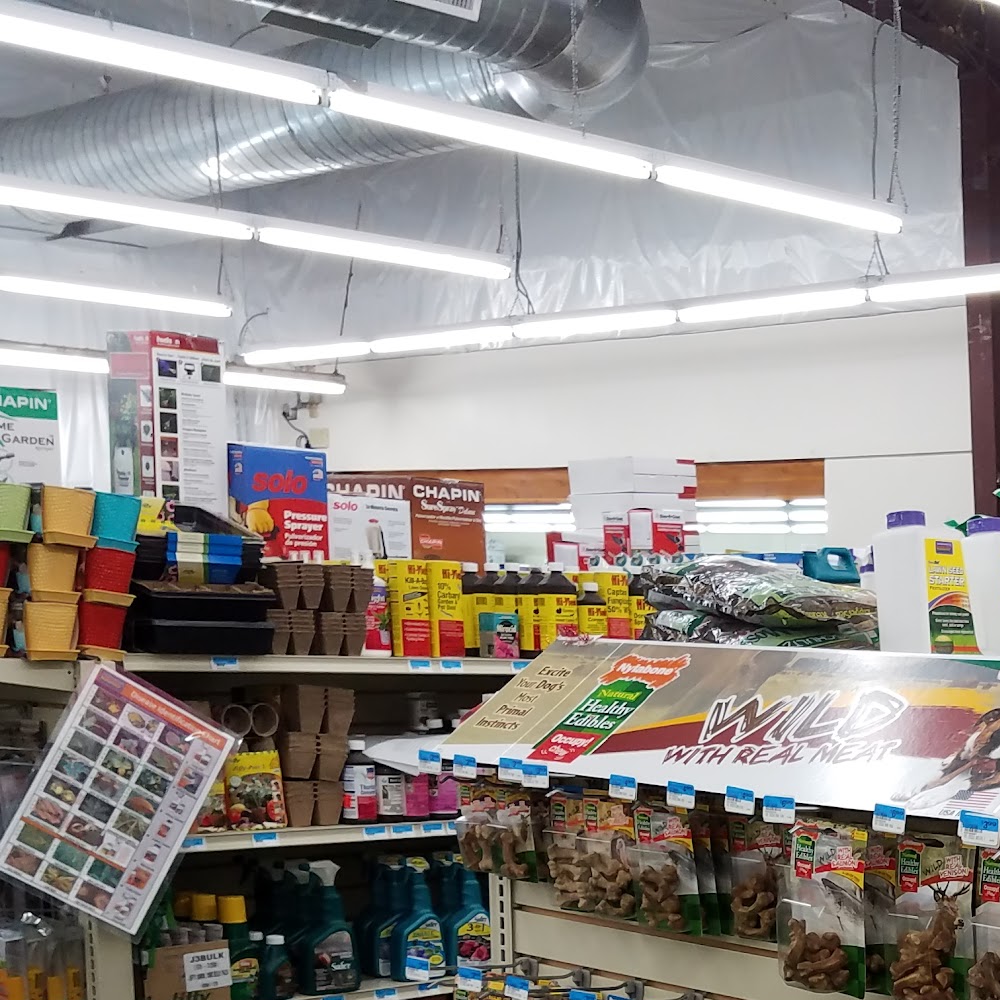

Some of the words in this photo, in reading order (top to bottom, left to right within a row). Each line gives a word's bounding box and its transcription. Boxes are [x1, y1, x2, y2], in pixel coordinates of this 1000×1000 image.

[0, 395, 48, 410] APIN
[2, 434, 54, 446] GARDEN
[252, 470, 307, 494] solo
[413, 485, 480, 502] CHAPIN
[333, 502, 358, 511] solo
[284, 510, 327, 522] Pressure
[284, 520, 323, 532] Sprayer
[929, 576, 965, 586] STARTER
[538, 667, 571, 678] Excite
[617, 663, 672, 676] Nylabone
[517, 679, 536, 688] Your
[536, 680, 564, 692] Dog's
[515, 693, 538, 703] Most
[600, 689, 641, 701] Natural
[497, 705, 532, 717] Primal
[579, 699, 635, 716] Healthy
[564, 713, 616, 730] Edibles
[699, 687, 908, 745] WILD
[476, 717, 520, 731] Instincts
[551, 734, 595, 747] Occupy!
[663, 745, 734, 765] WITH
[733, 745, 804, 765] REAL
[809, 740, 901, 765] MEAT
[819, 849, 836, 864] WILD
[901, 857, 920, 867] Healthy
[901, 866, 919, 874] Edibles
[922, 859, 943, 876] WILD
[940, 868, 968, 878] VENISON
[331, 961, 352, 971] Safer
